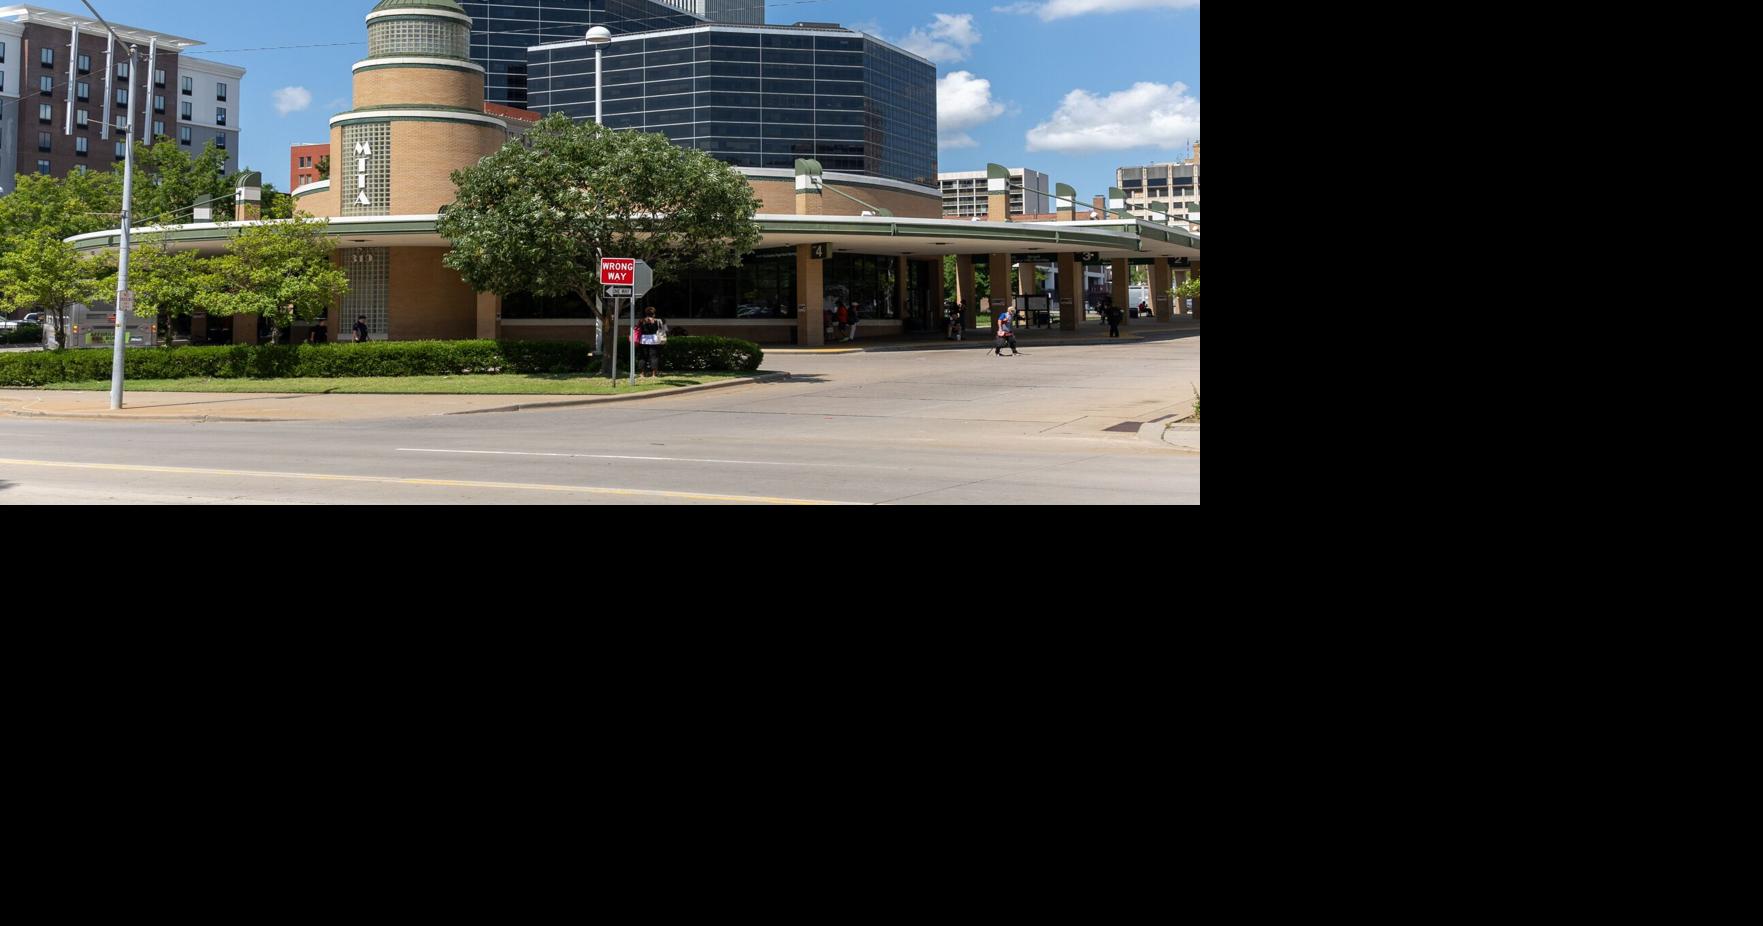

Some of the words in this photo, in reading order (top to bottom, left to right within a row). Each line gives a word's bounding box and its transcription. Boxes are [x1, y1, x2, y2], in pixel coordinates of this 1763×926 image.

[815, 244, 823, 256] 4
[1082, 252, 1091, 261] 3
[602, 262, 633, 270] WRONG
[607, 272, 627, 280] WAY
